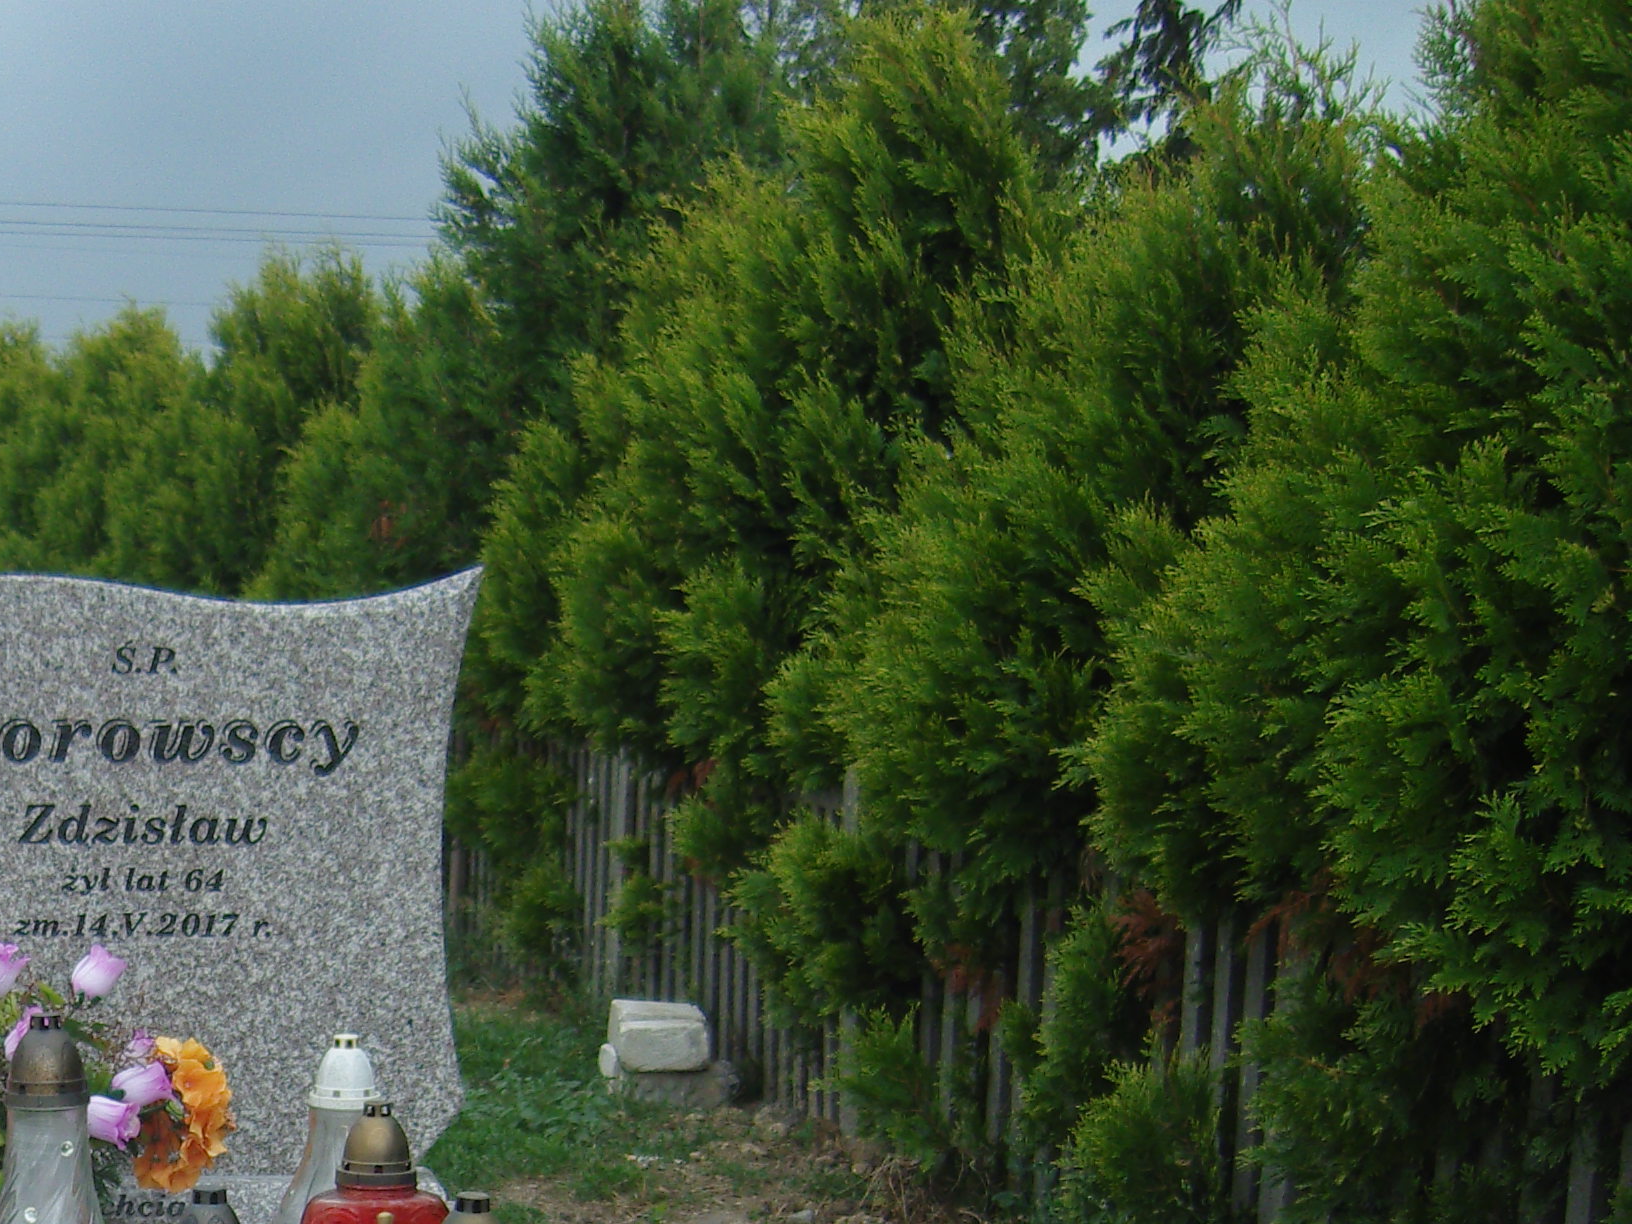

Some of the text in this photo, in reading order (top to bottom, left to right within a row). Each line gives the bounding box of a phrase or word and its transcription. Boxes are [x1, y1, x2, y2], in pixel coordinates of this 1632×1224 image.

[111, 641, 178, 676] Ś.P.
[18, 803, 268, 846] Zdzisław
[61, 867, 225, 895] żył lat 64
[252, 917, 272, 938] r.
